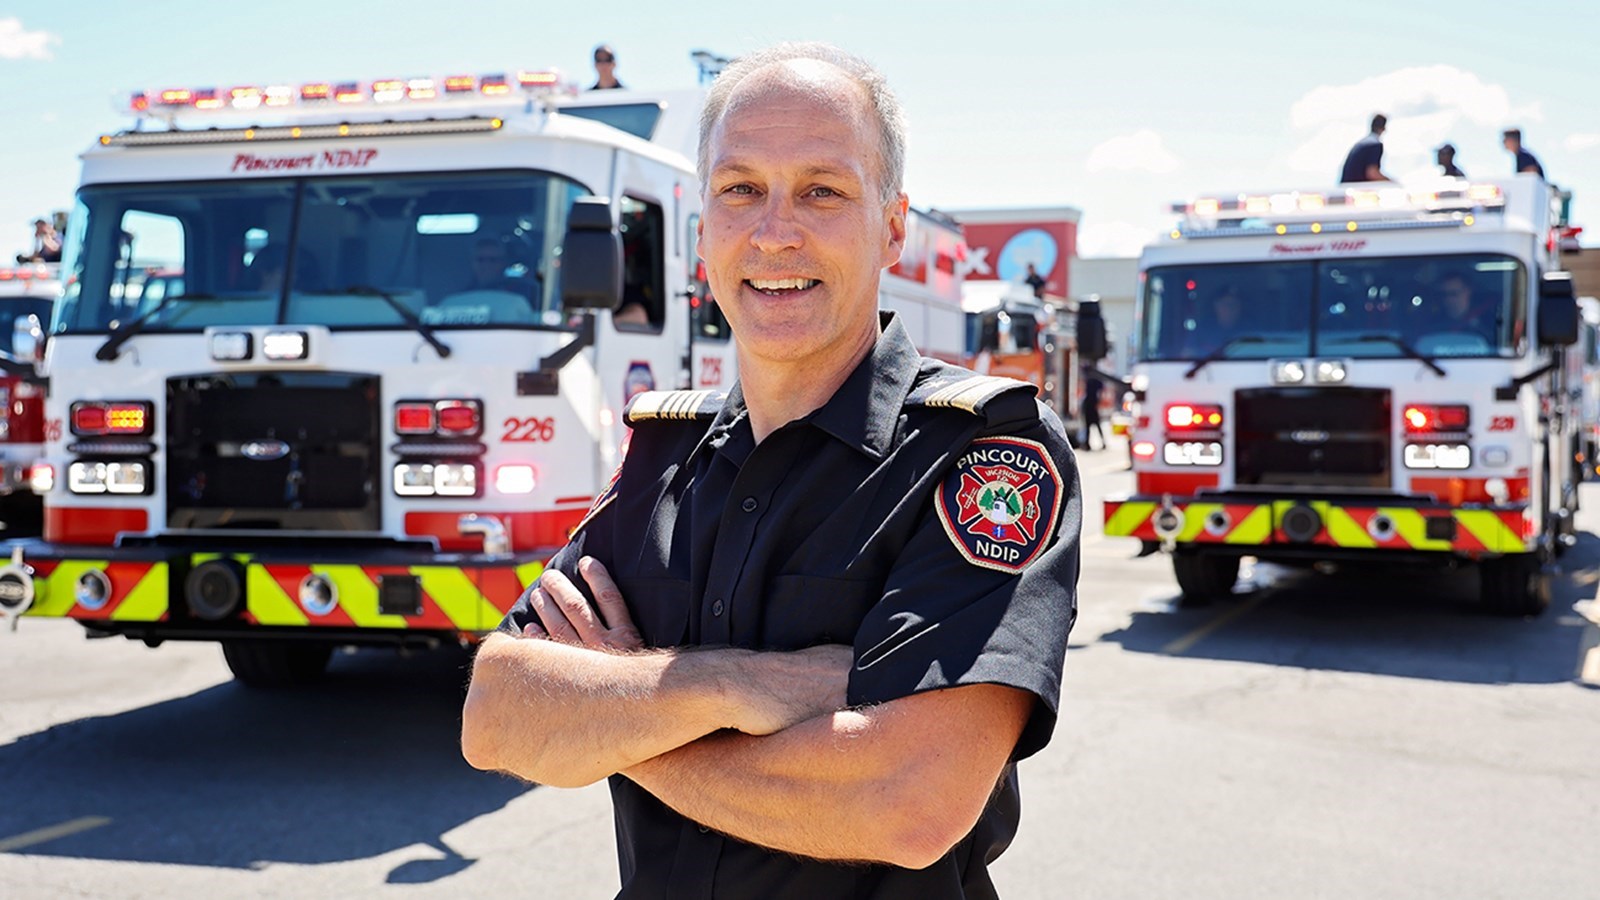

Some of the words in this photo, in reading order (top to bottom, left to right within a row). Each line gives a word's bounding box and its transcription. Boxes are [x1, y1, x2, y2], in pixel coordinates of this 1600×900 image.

[320, 148, 378, 167] NDIP
[501, 417, 555, 442] 226
[957, 449, 1050, 481] PINCOURT
[975, 540, 1020, 563] NDIP
